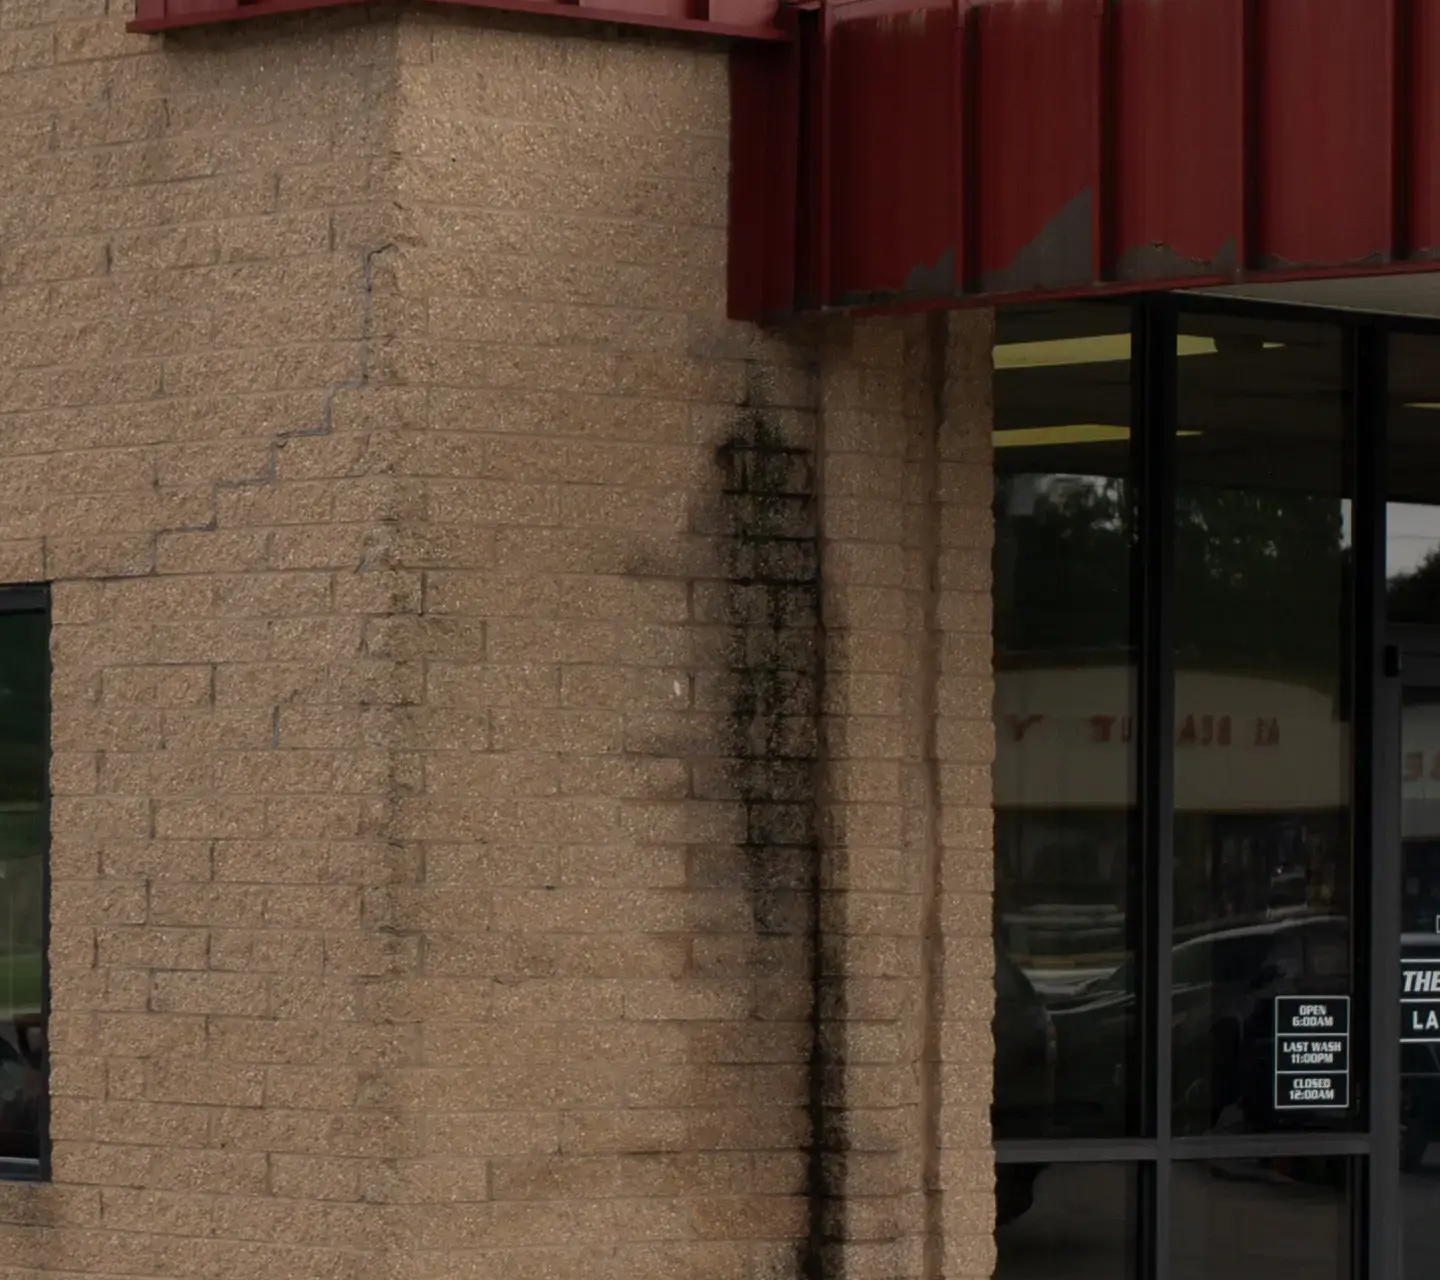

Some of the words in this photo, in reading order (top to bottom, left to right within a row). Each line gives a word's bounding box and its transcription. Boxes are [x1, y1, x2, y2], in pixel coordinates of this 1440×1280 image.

[1299, 1004, 1327, 1016] OPEN
[1292, 1015, 1334, 1027] 6:00AM
[1283, 1041, 1309, 1053] LAST
[1310, 1041, 1342, 1053] WASH
[1291, 1052, 1334, 1064] 11:00PM
[1293, 1077, 1332, 1089] CLOSED
[1289, 1088, 1335, 1101] 12:00AM
